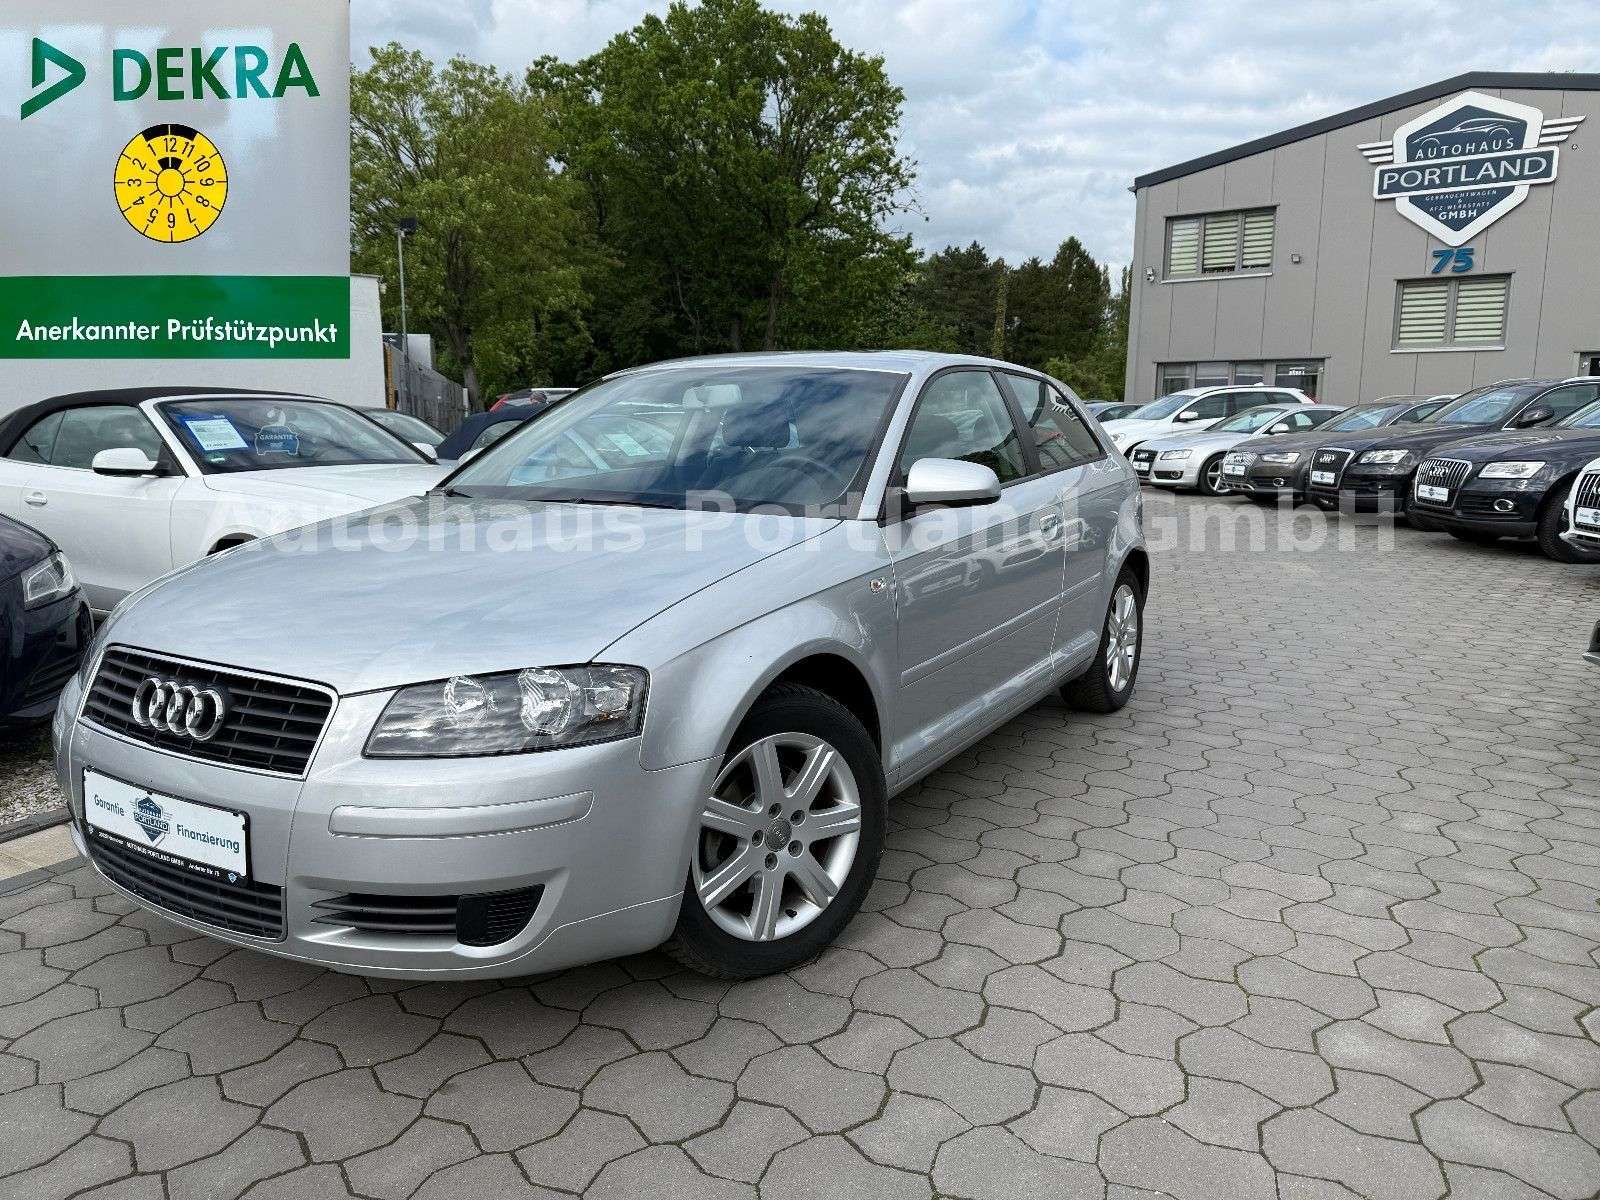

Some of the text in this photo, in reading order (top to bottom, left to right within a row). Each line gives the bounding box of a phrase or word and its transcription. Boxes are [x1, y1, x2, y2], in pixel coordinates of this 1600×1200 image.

[1415, 137, 1515, 160] AUTOHAUS
[1382, 156, 1548, 190] PORTLAND
[1438, 209, 1478, 220] GMBH
[1432, 248, 1475, 274] 75
[94, 794, 125, 817] Garantie
[176, 823, 240, 854] Finanzierung
